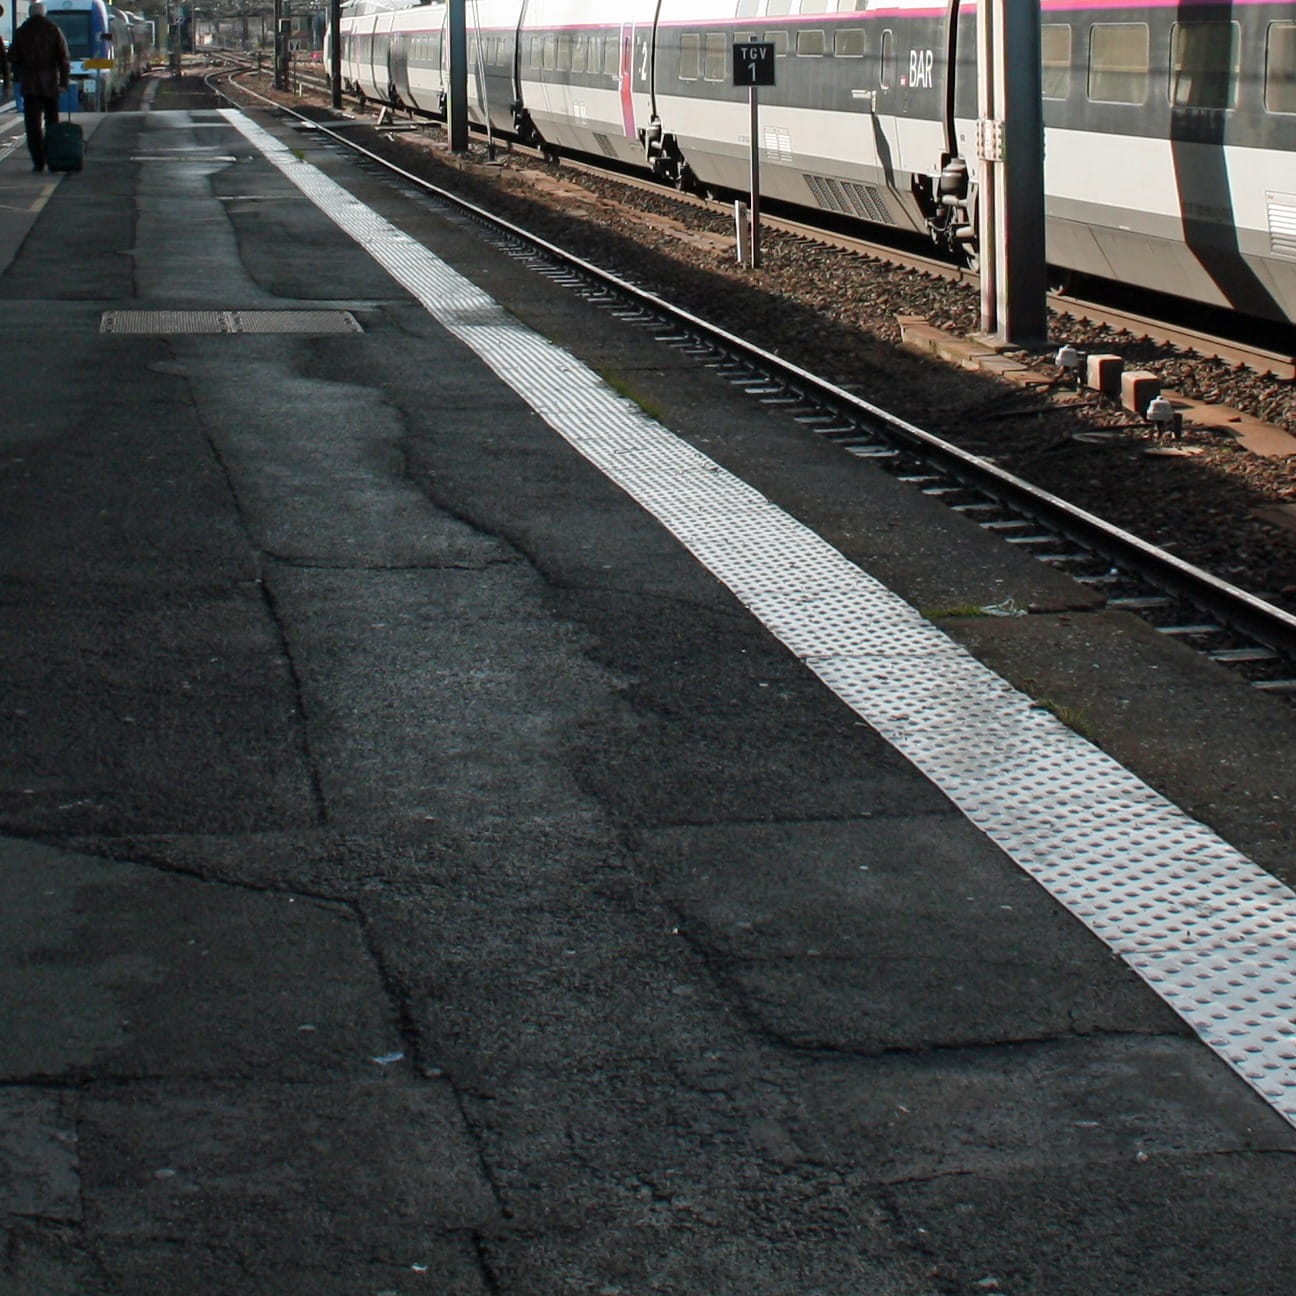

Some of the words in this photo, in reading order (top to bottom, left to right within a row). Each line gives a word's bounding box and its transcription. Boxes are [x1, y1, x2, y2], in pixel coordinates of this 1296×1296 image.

[640, 40, 648, 81] 2
[740, 47, 767, 60] TGV
[747, 62, 756, 82] 1
[909, 49, 934, 89] BAR
